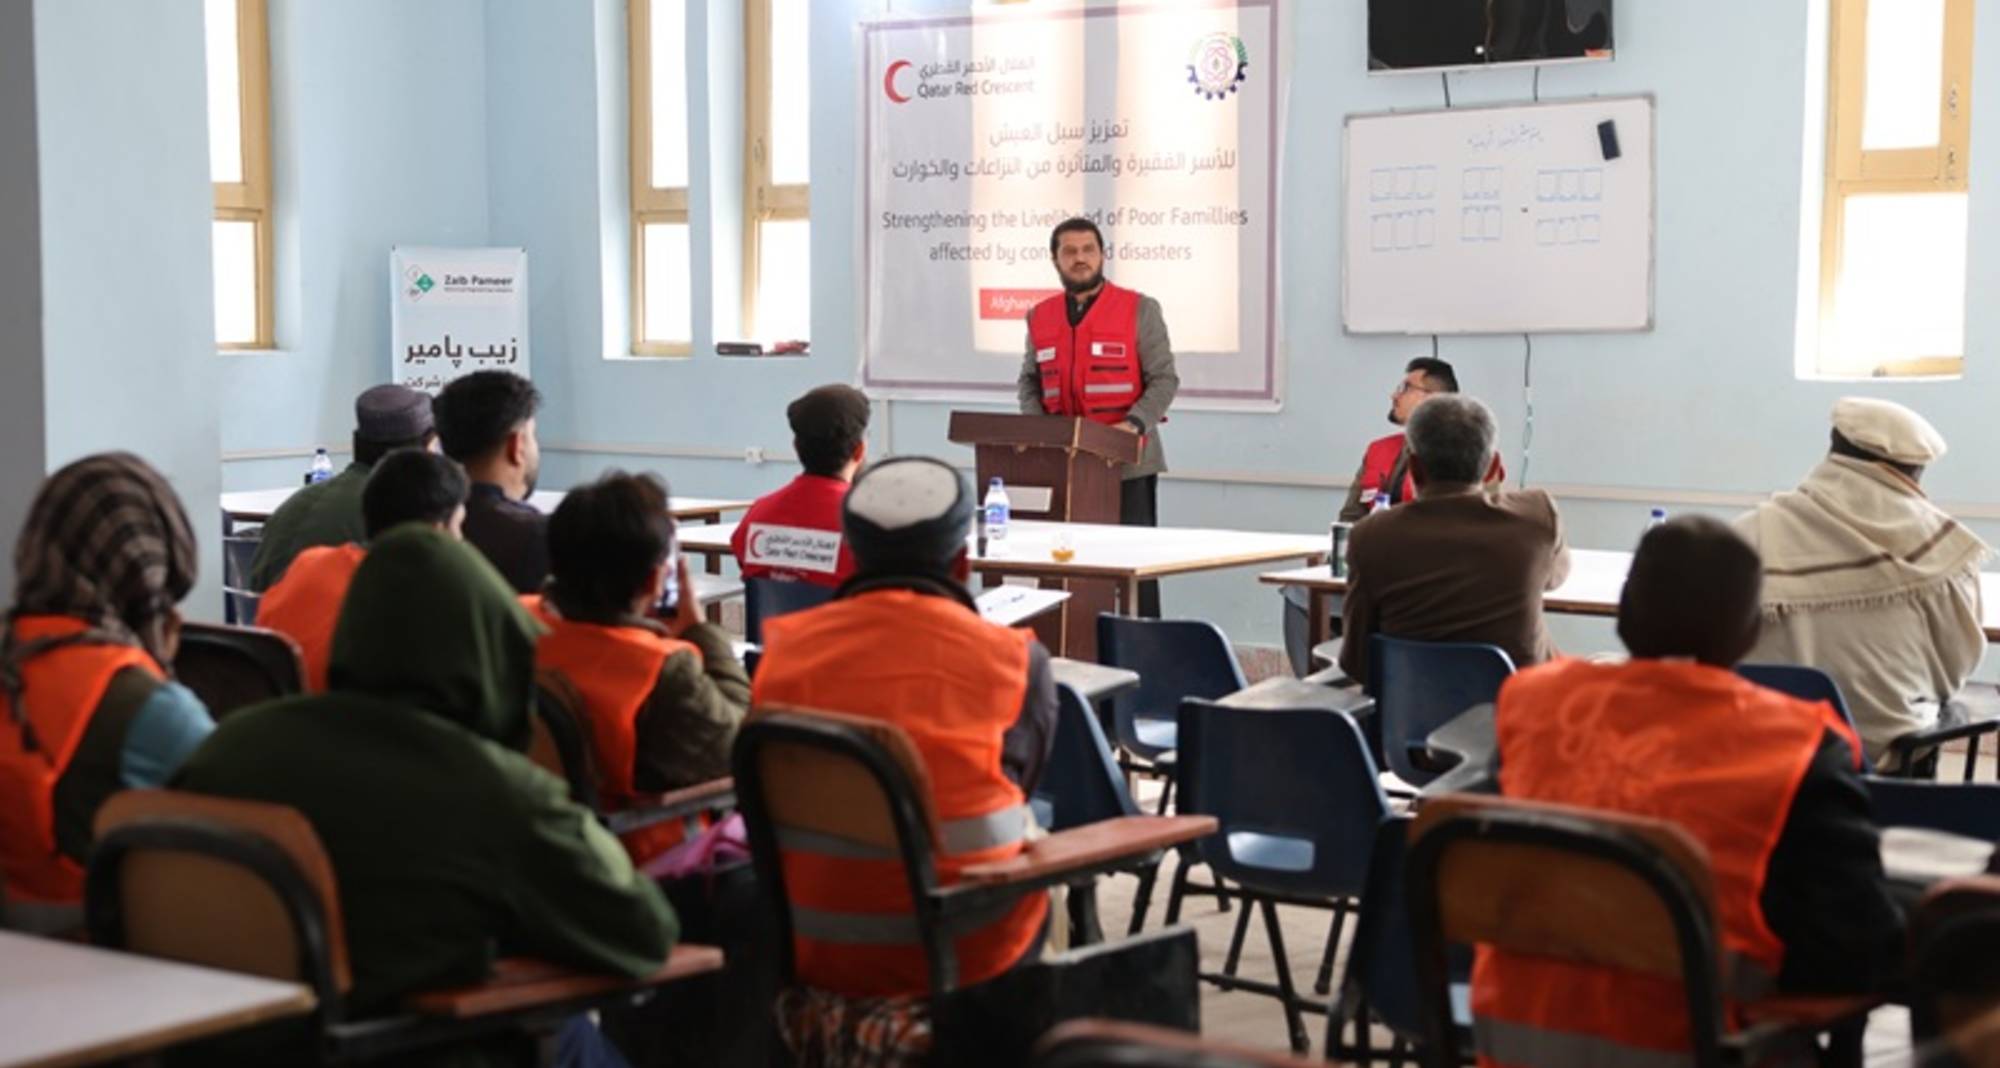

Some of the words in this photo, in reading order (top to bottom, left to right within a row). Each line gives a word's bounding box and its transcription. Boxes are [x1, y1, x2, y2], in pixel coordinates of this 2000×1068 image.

[919, 59, 961, 80] القطري
[917, 83, 952, 100] Qatar
[955, 80, 978, 96] Red
[981, 78, 1034, 95] Crescent
[989, 121, 1043, 148] العيش
[1047, 121, 1086, 145] سبل
[1088, 118, 1129, 144] تعزيز
[892, 158, 959, 182] والكوارث
[963, 156, 1021, 181] النزاعات
[1025, 158, 1051, 180] من
[1056, 149, 1122, 178] والمتأثرة
[1127, 151, 1186, 178] الفقيرة
[1189, 146, 1236, 175] للأسر
[881, 209, 986, 233] Strengthening
[992, 209, 1017, 228] the
[1106, 207, 1126, 226] of
[1128, 207, 1166, 226] Poor
[1170, 205, 1248, 226] Famillies
[929, 241, 992, 261] affected
[996, 242, 1016, 265] by
[1118, 241, 1193, 261] disasters
